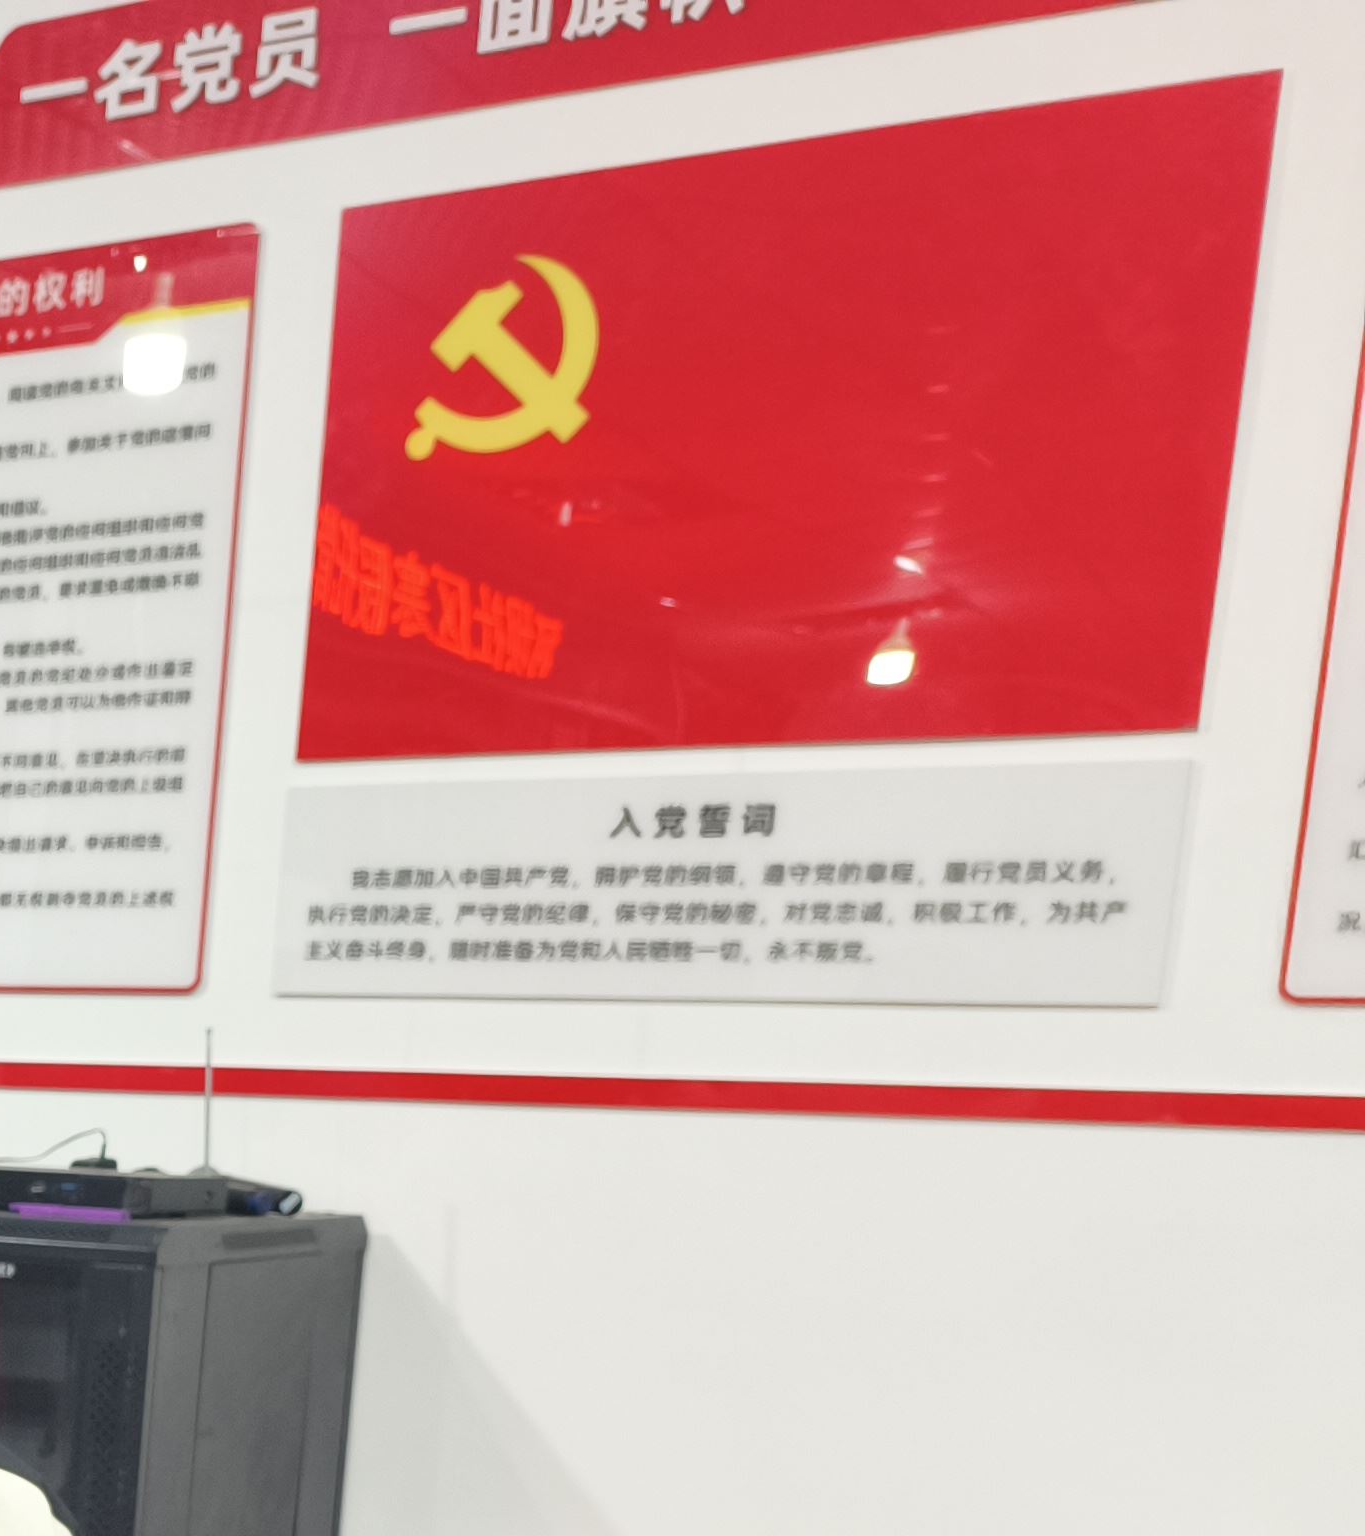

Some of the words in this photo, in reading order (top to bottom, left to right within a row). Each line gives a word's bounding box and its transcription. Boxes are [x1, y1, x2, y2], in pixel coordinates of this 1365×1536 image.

[17, 8, 322, 122] 一名党员
[388, 0, 747, 55] 一面旗
[608, 802, 776, 840] 入党誓词
